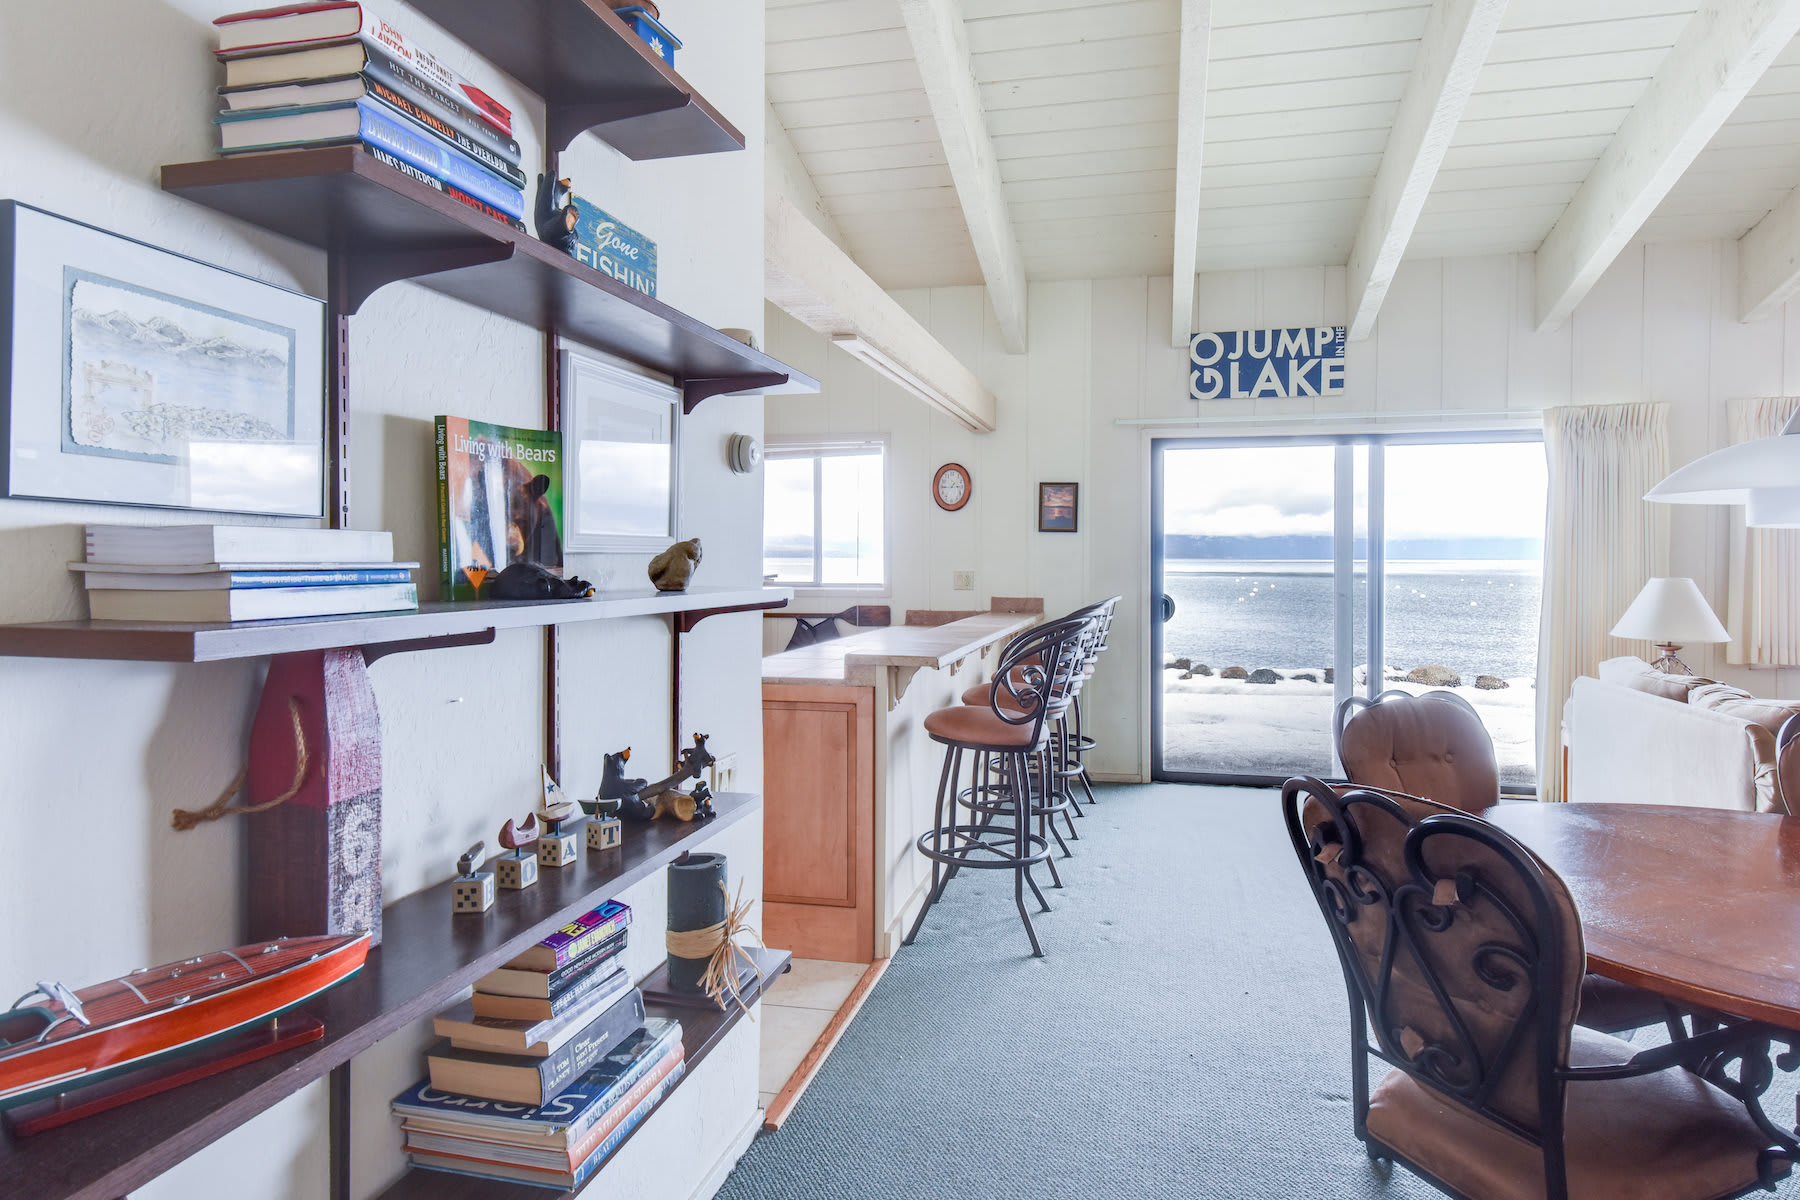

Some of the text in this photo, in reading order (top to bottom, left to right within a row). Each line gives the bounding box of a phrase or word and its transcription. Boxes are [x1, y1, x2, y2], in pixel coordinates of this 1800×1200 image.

[372, 24, 412, 62] LAWTON
[380, 20, 403, 43] JOHN
[389, 61, 459, 113] HIT THE TARGET
[374, 82, 414, 114] MICHAEL
[415, 107, 455, 139] CONNELLY
[456, 132, 471, 149] THE
[473, 144, 508, 173] OVERLOOK
[596, 222, 639, 260] Gone
[576, 243, 655, 295] FISHIN'
[1227, 327, 1335, 360] JUMP
[1335, 326, 1345, 357] IN THE
[1190, 332, 1224, 400] GO
[1230, 358, 1344, 399] LAKE
[436, 424, 445, 444] Living
[454, 433, 486, 462] Living
[487, 440, 513, 460] with
[516, 443, 556, 463] Bears
[438, 446, 447, 460] with
[563, 841, 576, 860] A
[603, 826, 620, 845] T
[575, 1037, 591, 1053] Clear
[548, 1066, 571, 1091] CLANCY
[556, 1058, 569, 1073] TOM
